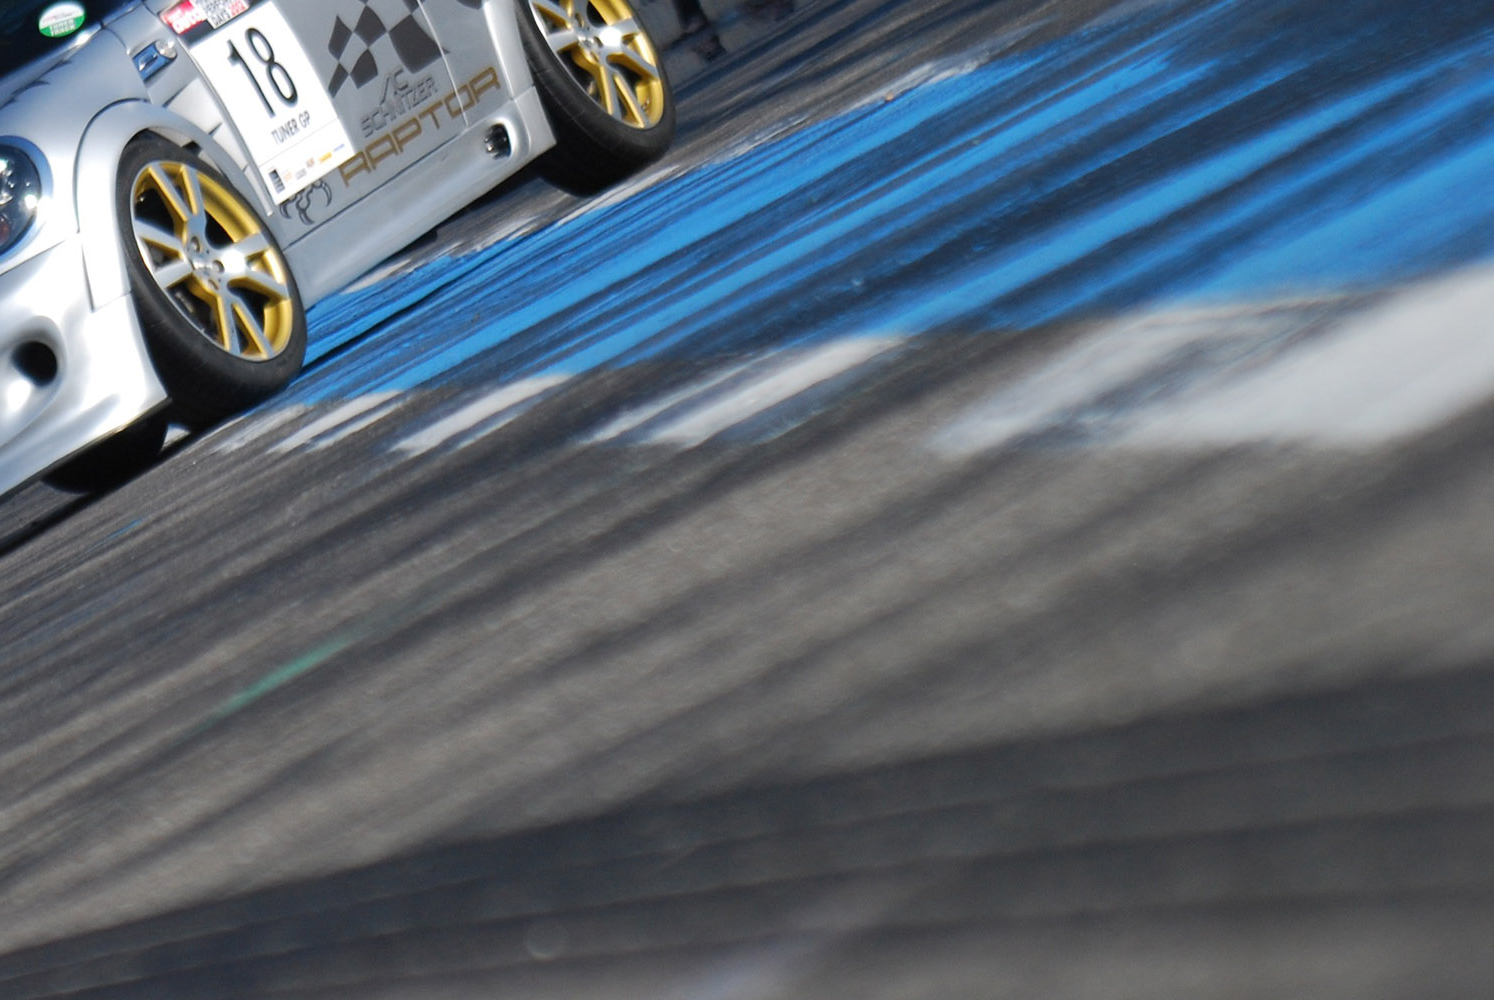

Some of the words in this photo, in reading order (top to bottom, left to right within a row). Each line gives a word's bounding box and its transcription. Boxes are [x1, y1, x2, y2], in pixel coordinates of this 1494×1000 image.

[227, 27, 298, 118] 18
[360, 75, 438, 137] SCHNITZER
[271, 118, 300, 144] TUNER
[299, 110, 311, 129] GP
[338, 66, 501, 187] RAPTOR
